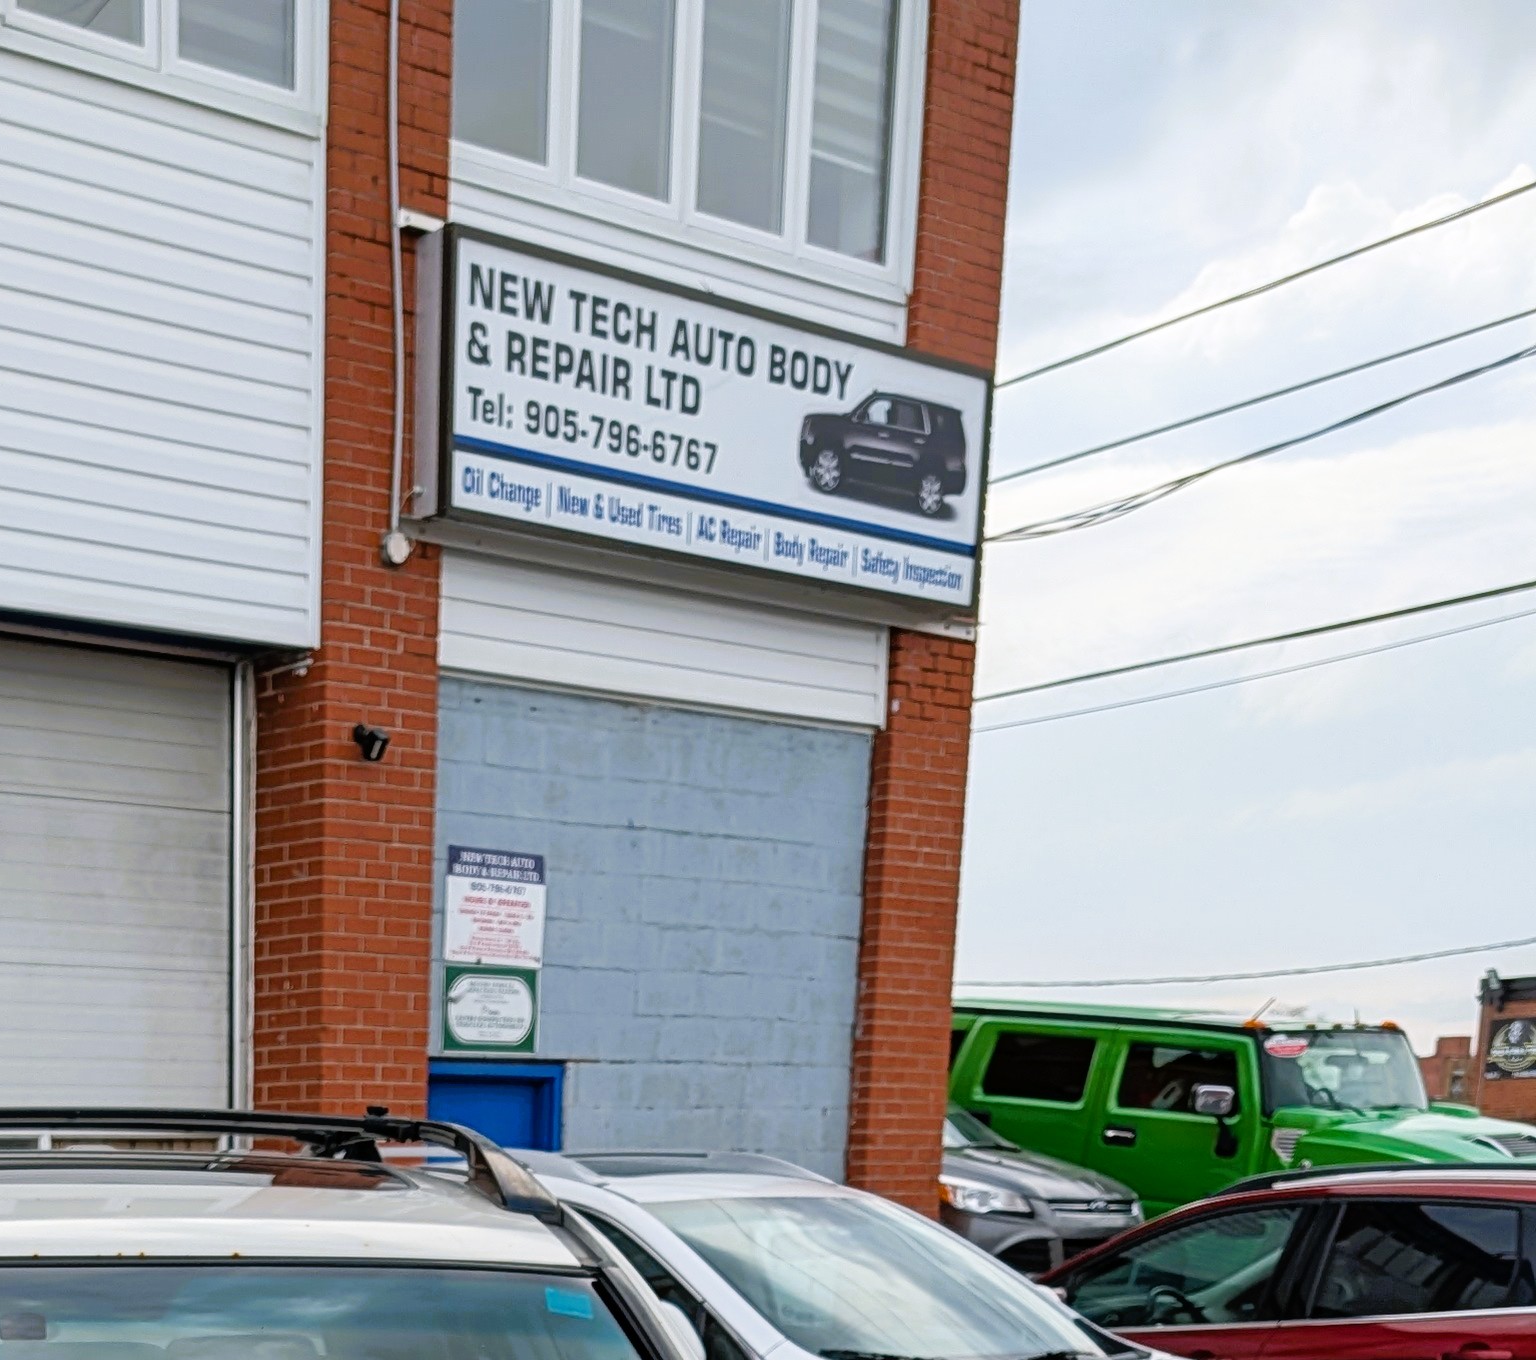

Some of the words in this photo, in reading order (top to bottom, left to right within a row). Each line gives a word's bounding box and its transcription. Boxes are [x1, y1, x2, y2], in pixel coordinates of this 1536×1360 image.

[467, 321, 491, 366] &
[506, 330, 631, 401] REPAIR
[644, 365, 701, 416] LTD
[469, 262, 555, 326] NEW
[569, 289, 658, 352] TECH
[669, 318, 755, 377] AUTO
[768, 344, 854, 400] BODY
[467, 385, 513, 430] Tel:
[524, 399, 719, 475] 905-796-6767
[463, 465, 484, 496] Oil
[487, 471, 542, 513] Change
[556, 484, 591, 517] New
[593, 493, 605, 520] &
[607, 496, 644, 528] Used
[647, 503, 683, 536] Tires
[696, 514, 716, 542] AC
[718, 518, 762, 554] Repair
[773, 530, 805, 566] Body
[808, 537, 849, 571] Repair
[860, 548, 900, 584] Safety
[902, 555, 963, 592] Inspection
[510, 857, 536, 870] AUTO
